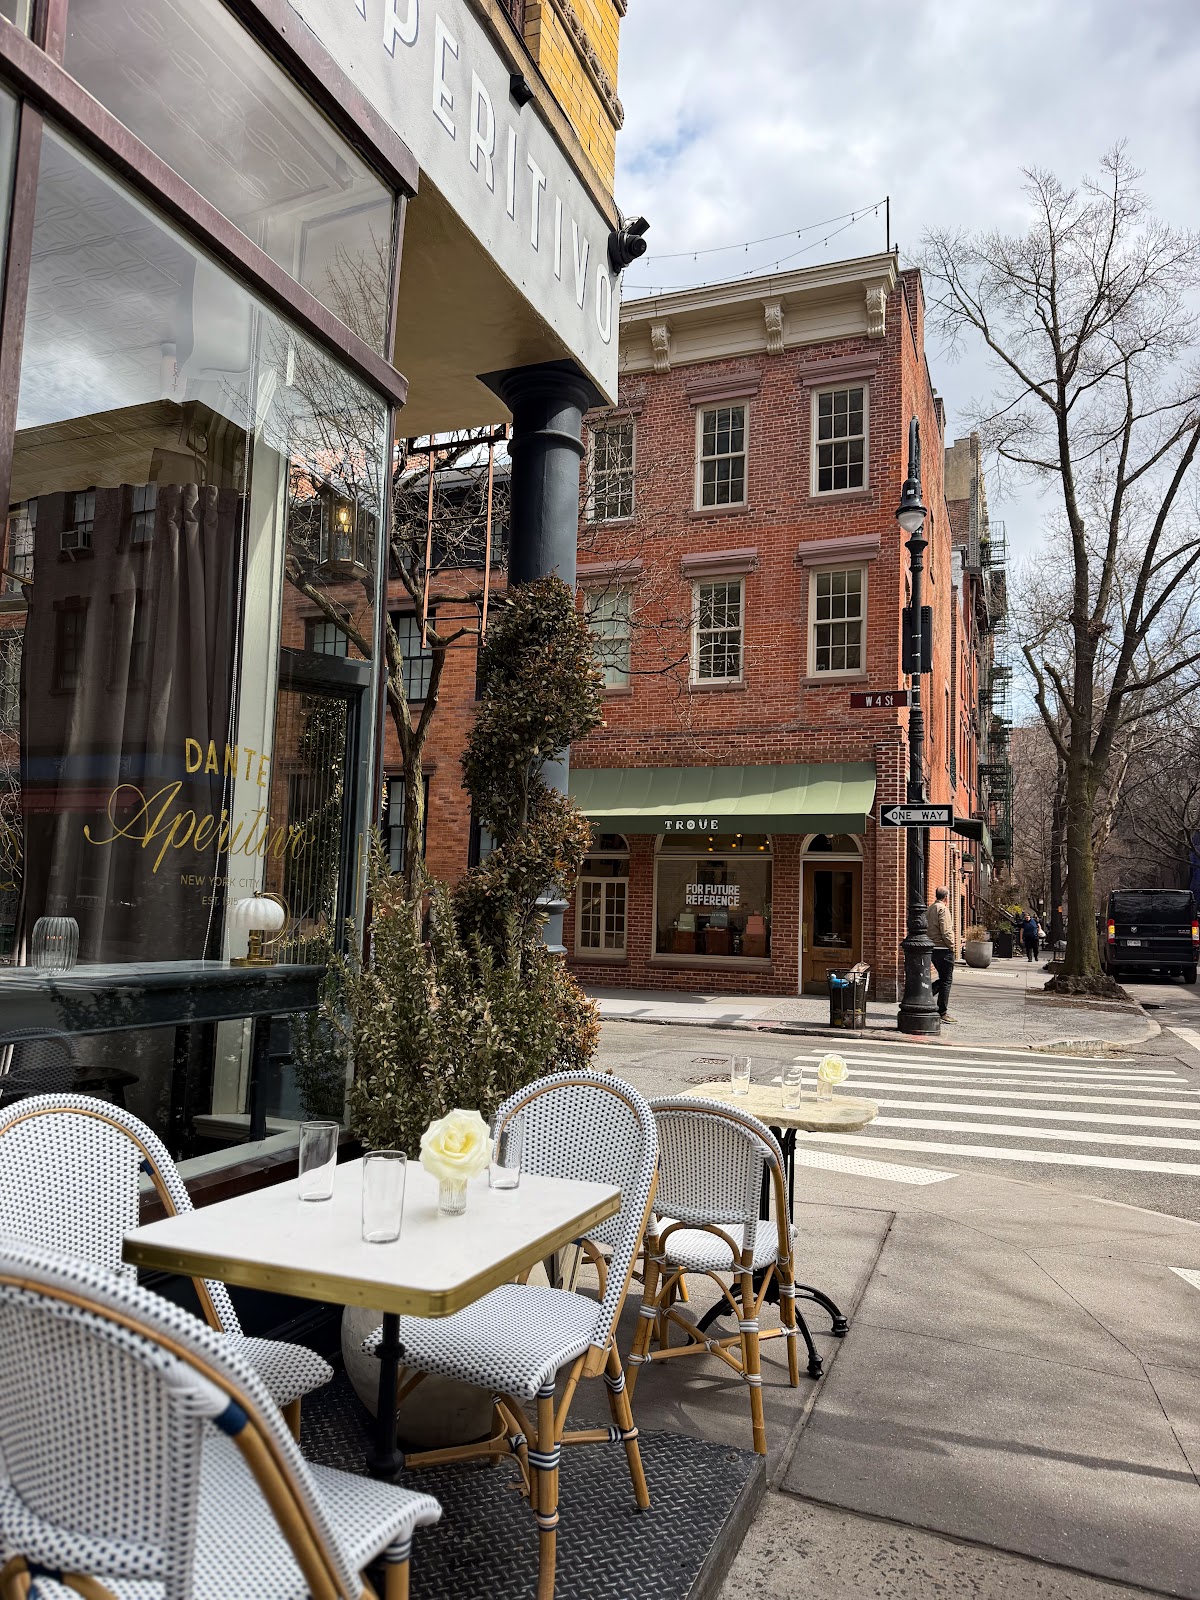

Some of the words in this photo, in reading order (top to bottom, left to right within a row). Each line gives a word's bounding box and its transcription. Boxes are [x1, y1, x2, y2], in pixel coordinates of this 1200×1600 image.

[355, 0, 612, 345] PERITIVO
[171, 362, 179, 392] EXIT
[865, 696, 873, 706] W
[875, 696, 882, 706] 4
[884, 695, 894, 706] St
[185, 738, 271, 787] DANTE
[892, 811, 912, 820] ONE
[921, 811, 944, 820] WAY
[83, 781, 315, 873] Aperitivo
[664, 818, 719, 830] TROVE
[180, 874, 206, 886] NEW
[209, 876, 236, 887] YORK
[239, 878, 260, 888] CITY
[686, 884, 703, 895] FOR
[705, 884, 740, 896] FUTURE
[685, 895, 740, 906] REFERENCE
